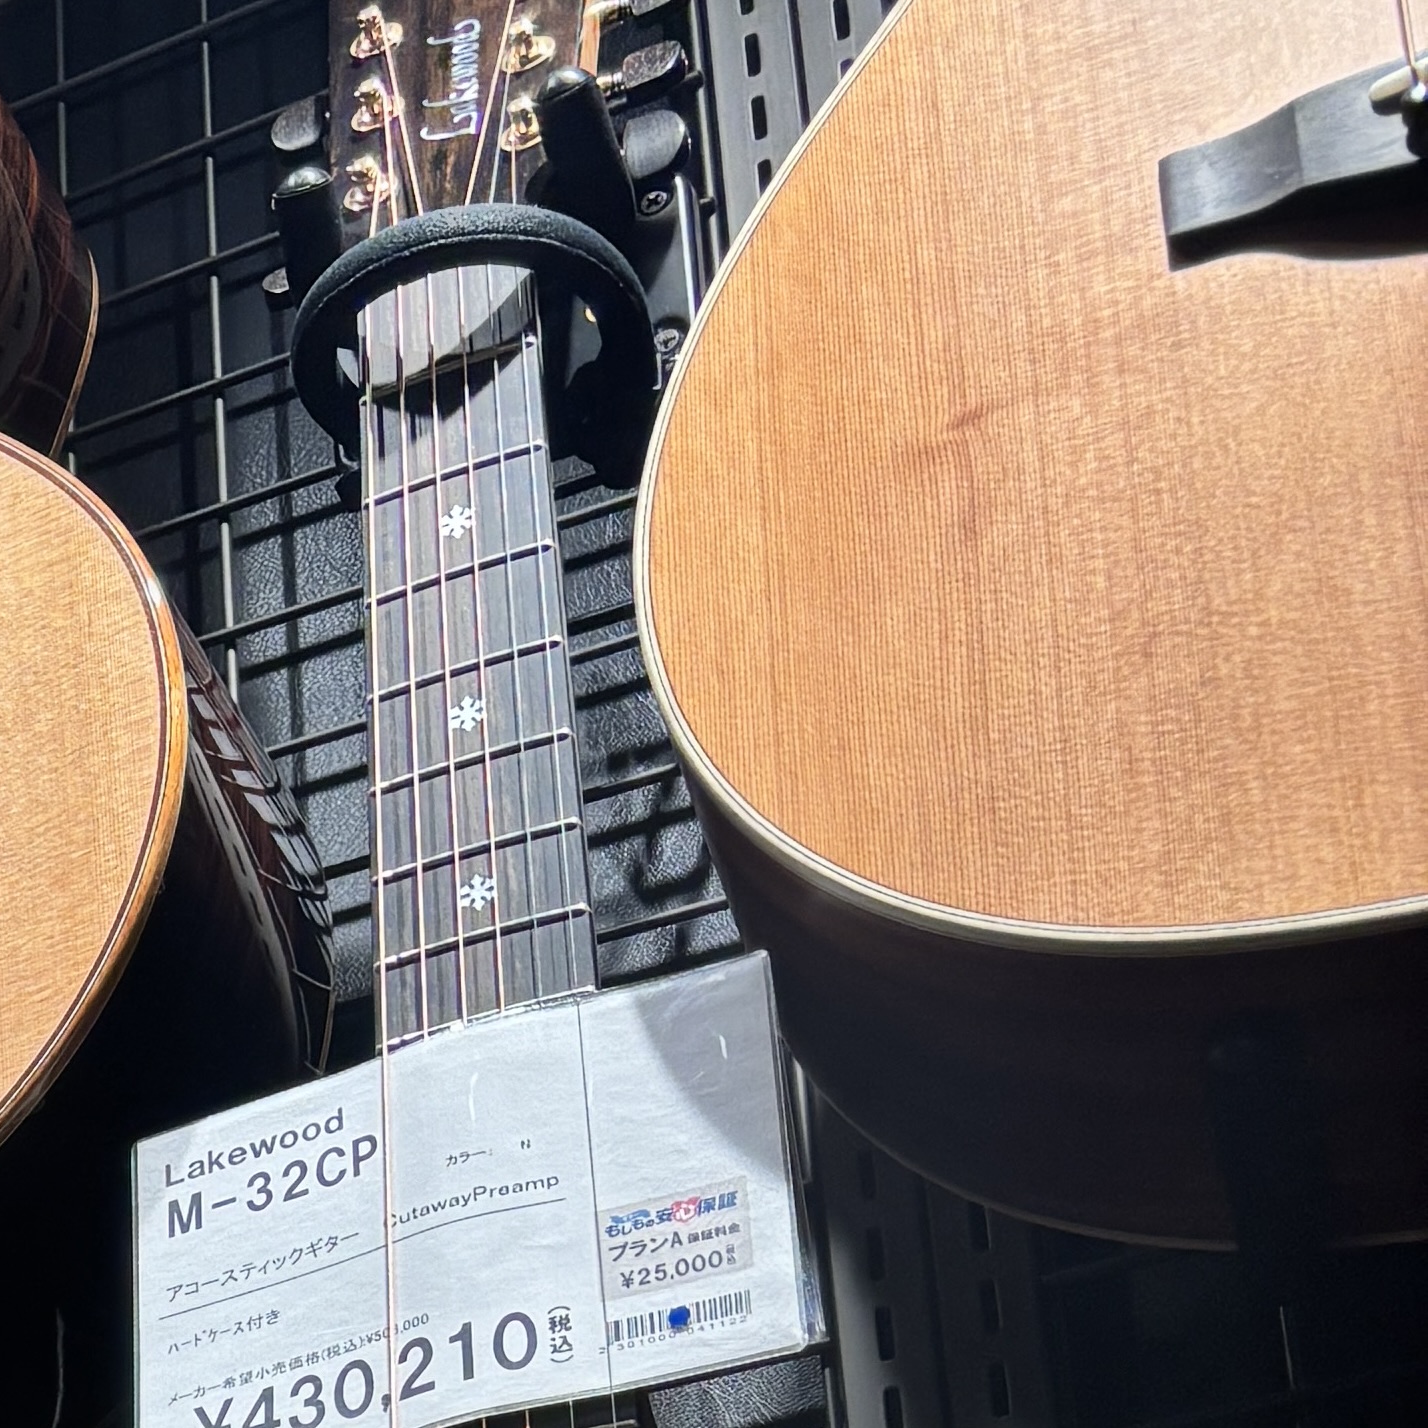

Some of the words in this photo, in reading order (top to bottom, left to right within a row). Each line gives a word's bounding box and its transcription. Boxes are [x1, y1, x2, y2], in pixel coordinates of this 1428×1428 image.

[165, 1107, 344, 1188] Lakewood
[168, 1134, 378, 1238] M-32CP
[166, 1233, 359, 1302] アコースティックギター
[608, 1231, 683, 1262] プランA
[620, 1250, 723, 1289] ¥25,000
